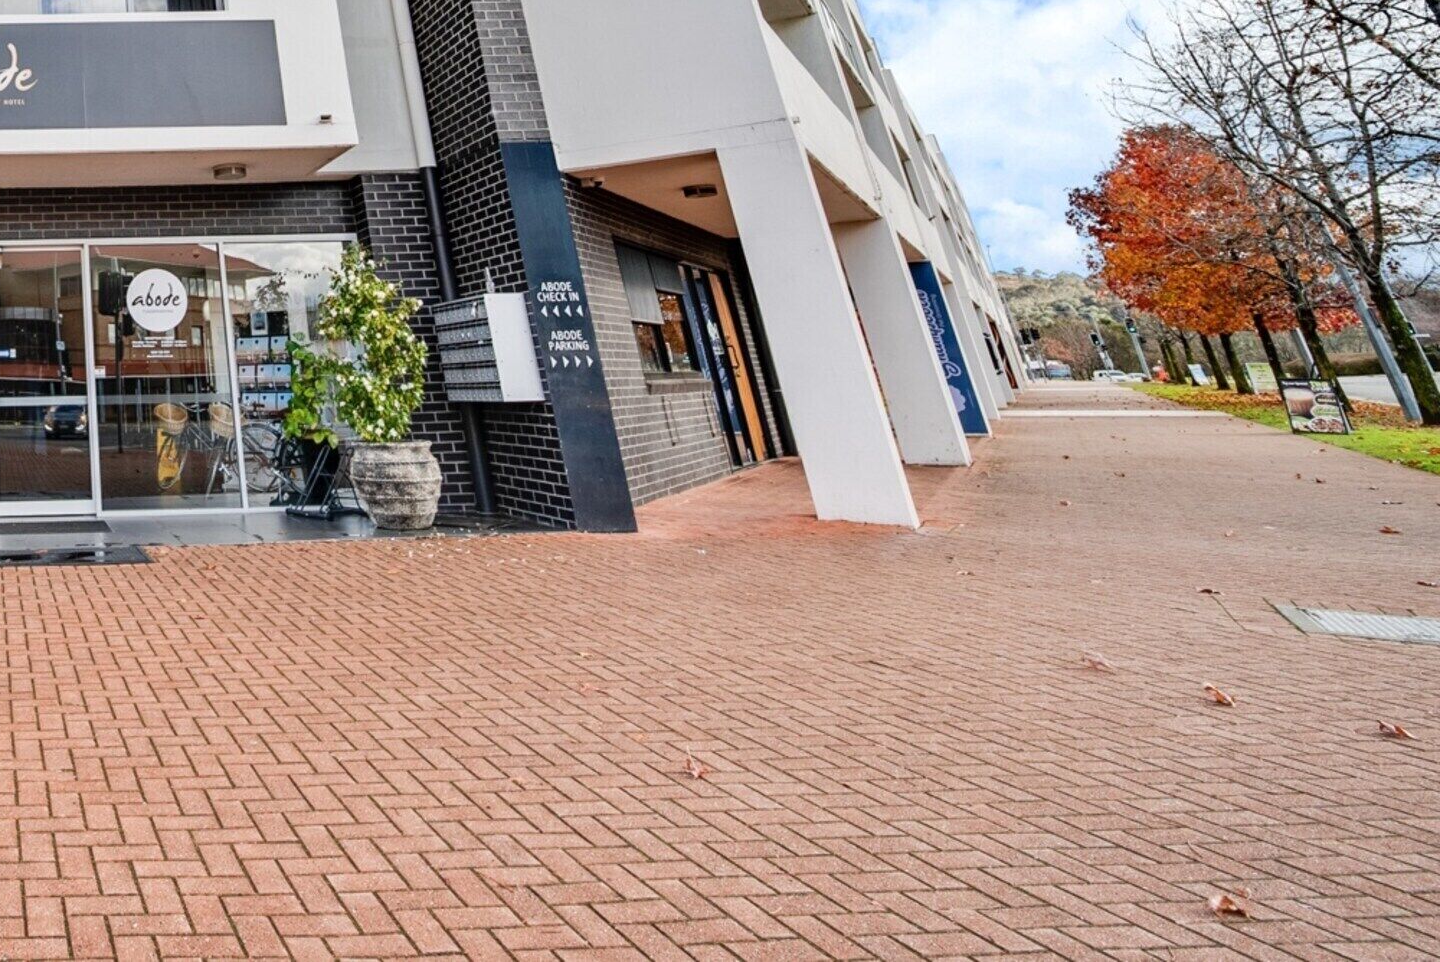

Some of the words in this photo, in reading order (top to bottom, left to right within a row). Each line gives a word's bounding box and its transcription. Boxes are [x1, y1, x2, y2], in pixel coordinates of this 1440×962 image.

[3, 98, 25, 106] HOTEL
[541, 281, 572, 292] ABODE
[132, 282, 181, 306] abode
[537, 292, 567, 302] CHECK
[568, 292, 580, 302] IN
[551, 330, 583, 340] ABODE
[548, 341, 590, 351] PARKING
